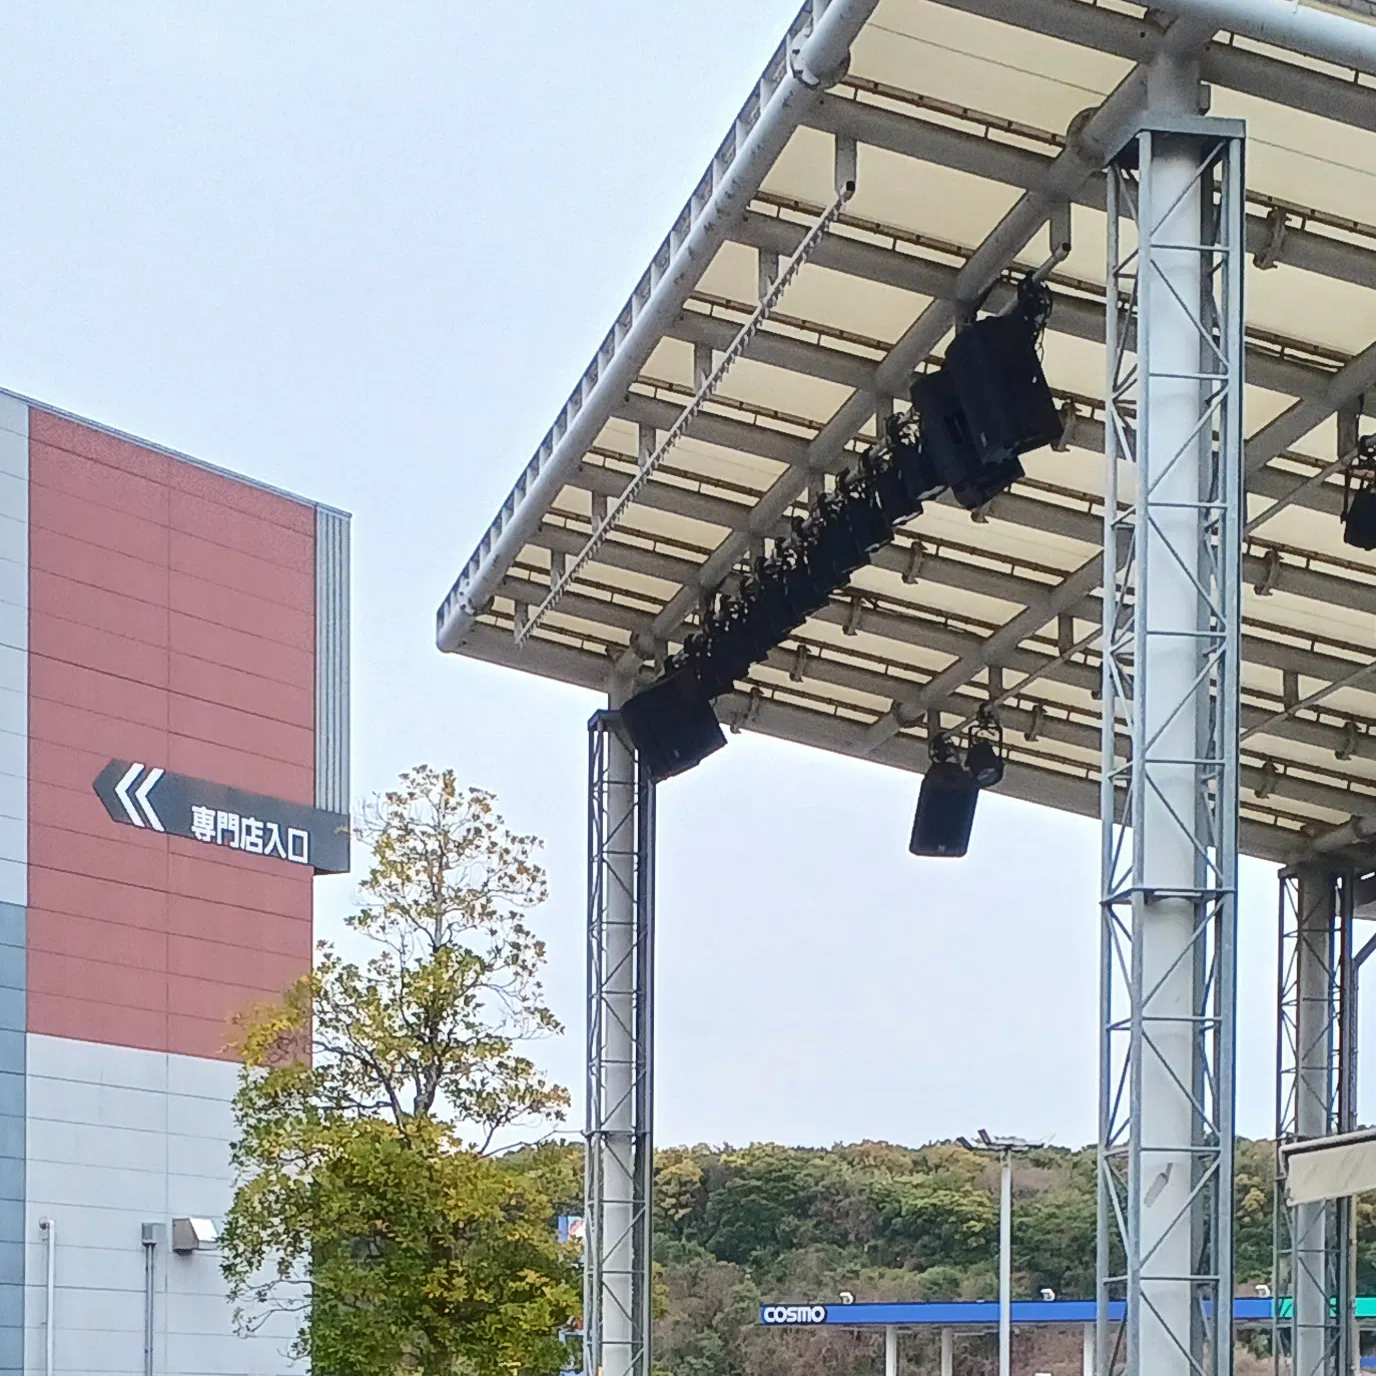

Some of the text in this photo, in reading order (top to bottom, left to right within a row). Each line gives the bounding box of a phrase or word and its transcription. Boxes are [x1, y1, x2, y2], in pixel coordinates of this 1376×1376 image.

[191, 805, 308, 864] 専門店入口
[764, 1306, 825, 1322] COSMO
